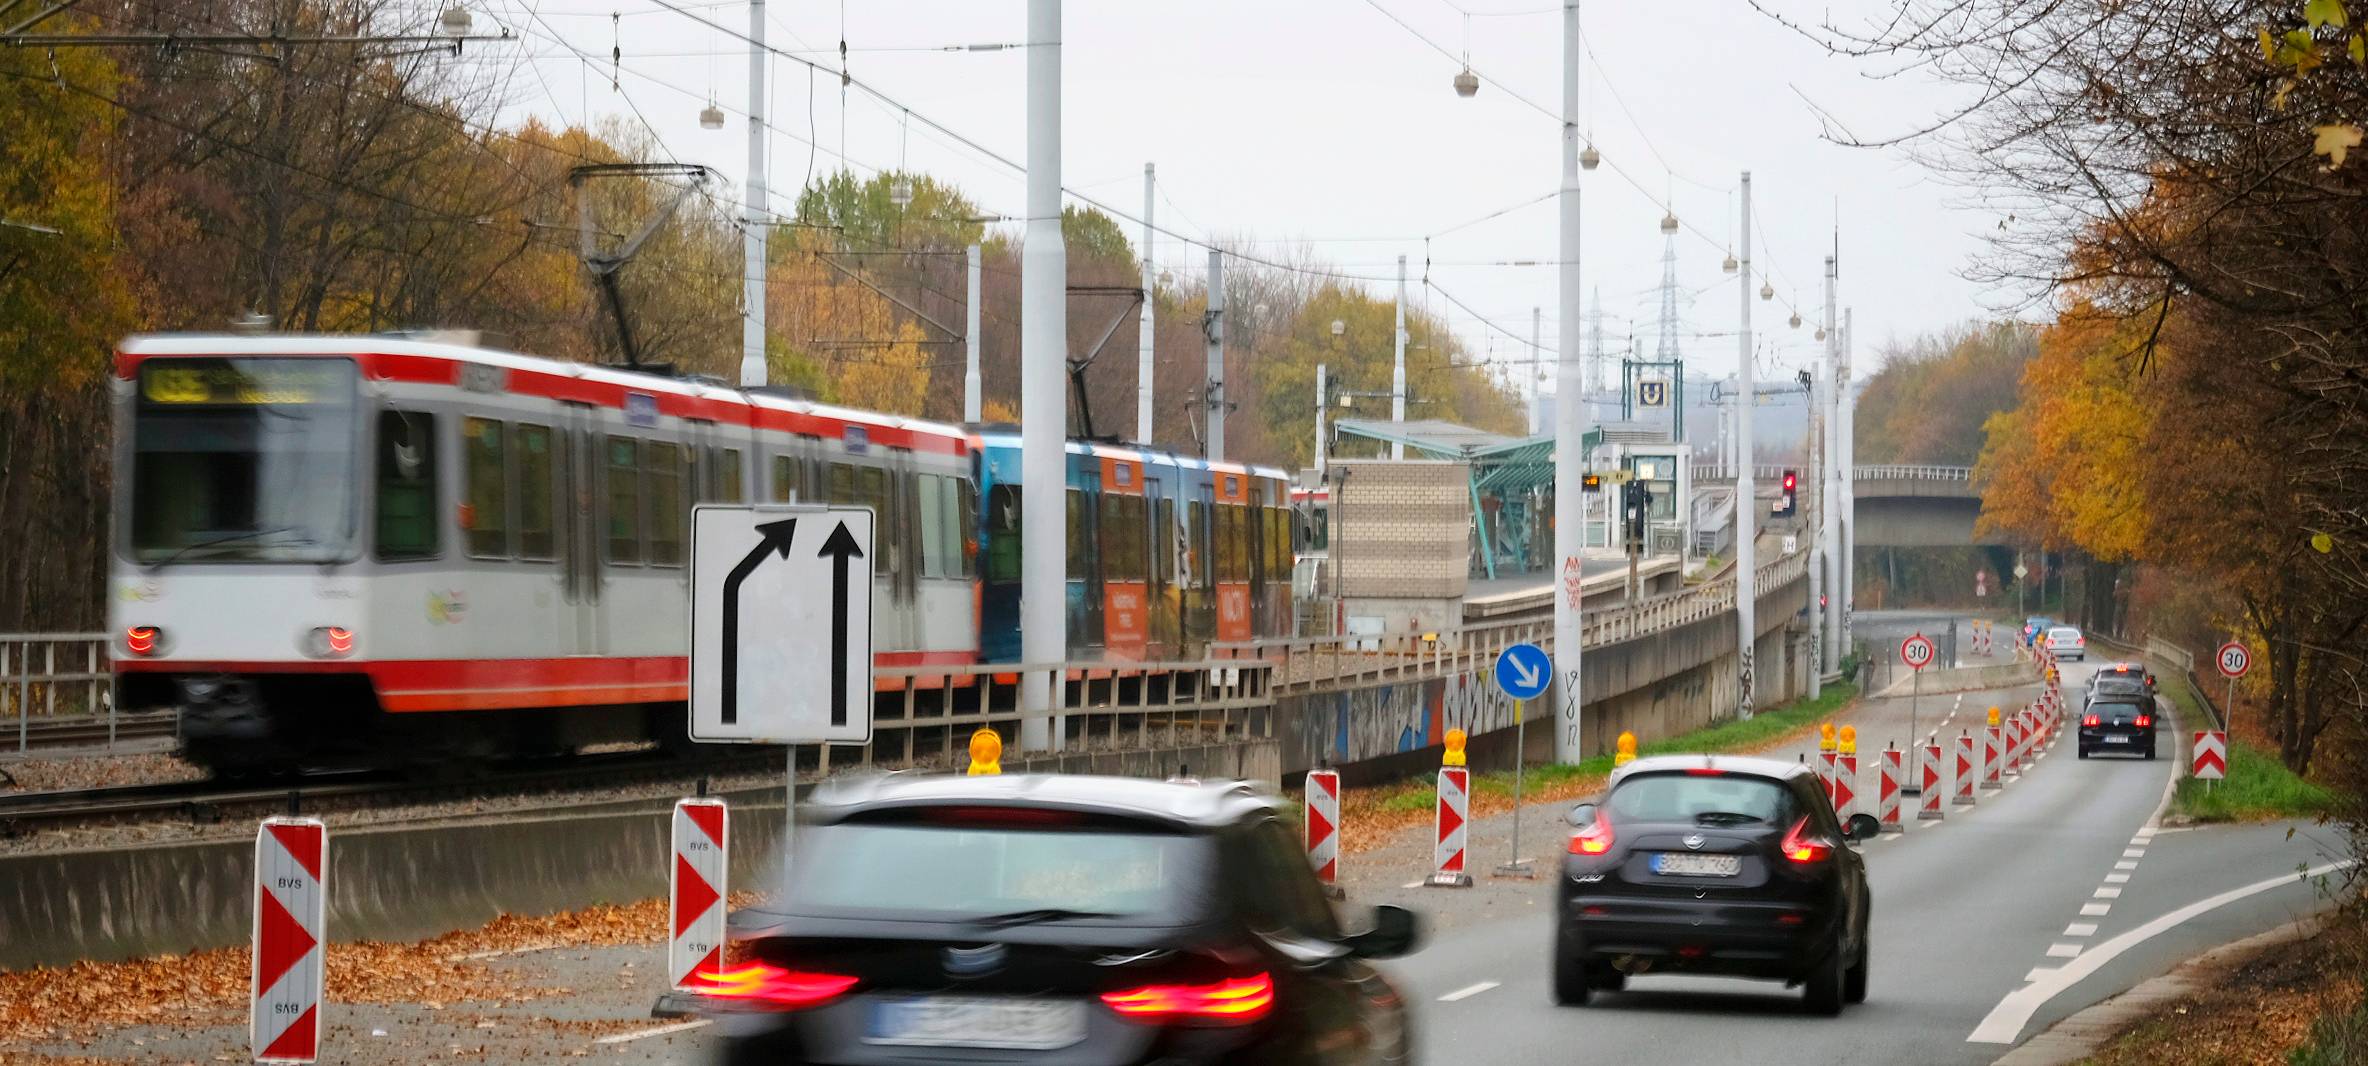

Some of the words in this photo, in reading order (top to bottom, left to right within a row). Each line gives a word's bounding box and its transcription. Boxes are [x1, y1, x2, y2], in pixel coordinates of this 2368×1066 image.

[1643, 384, 1660, 405] U
[1908, 644, 1926, 659] 30
[2225, 652, 2243, 668] 30
[278, 877, 302, 889] BVS
[275, 1004, 298, 1015] BVS
